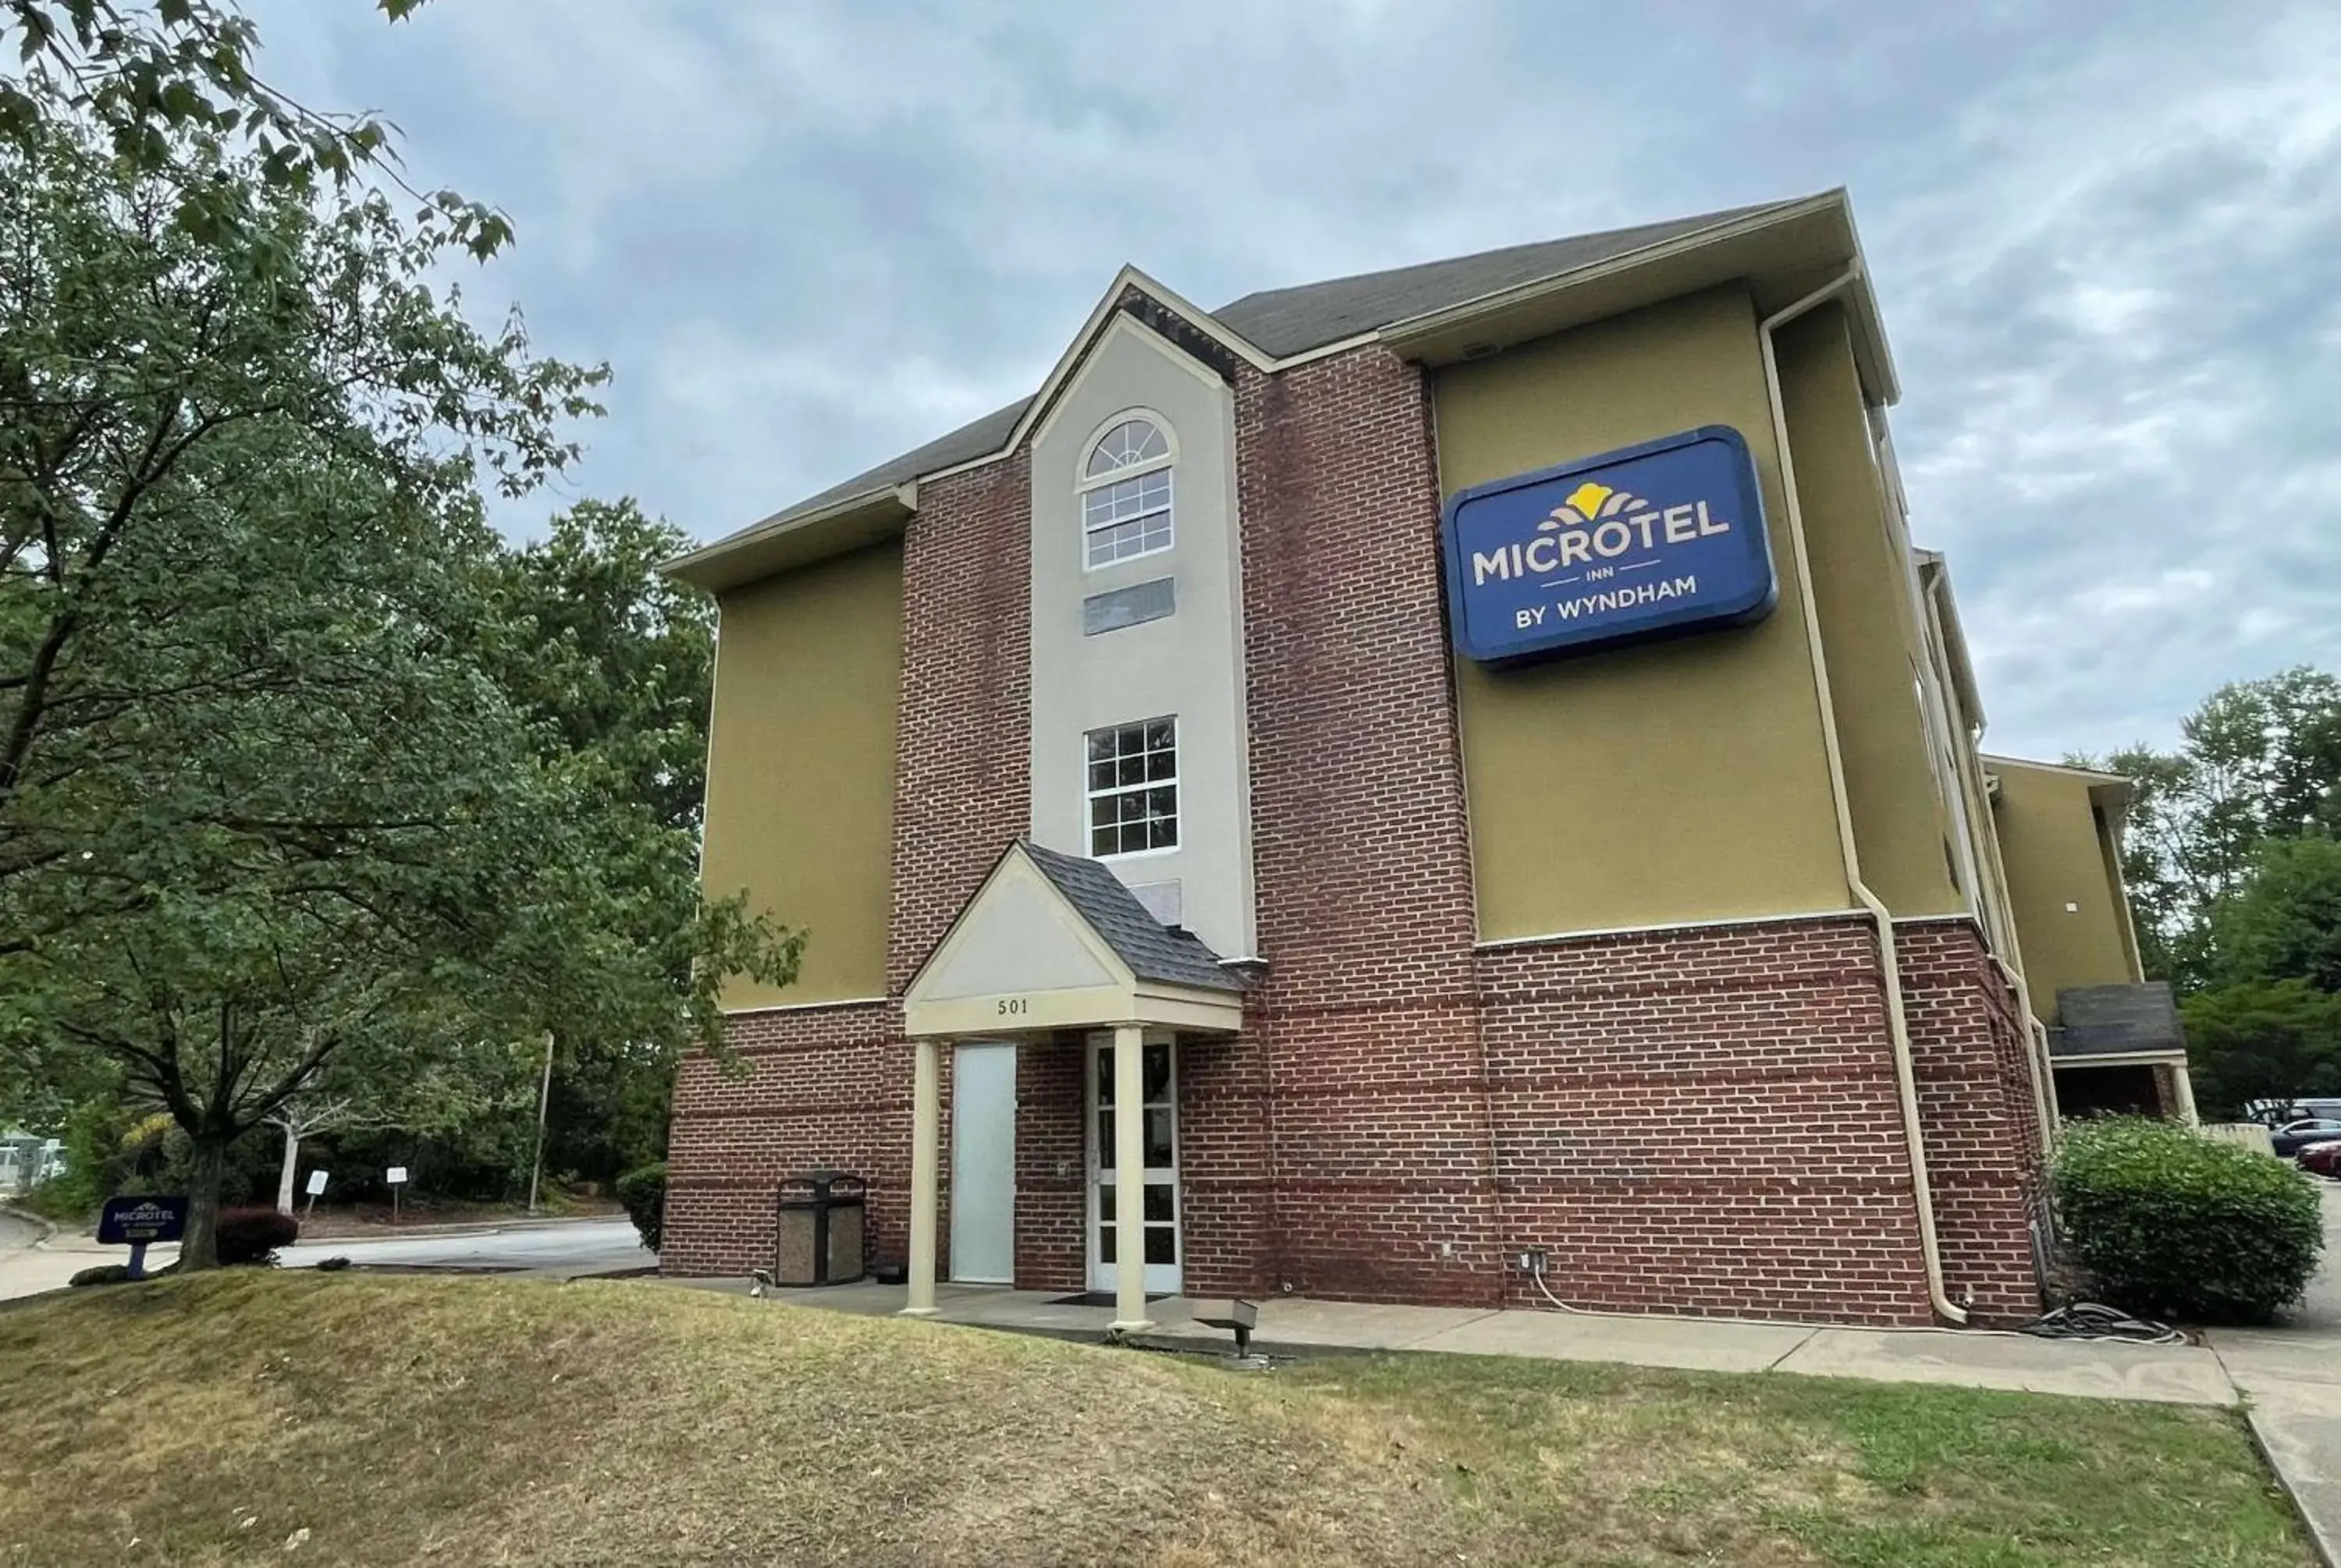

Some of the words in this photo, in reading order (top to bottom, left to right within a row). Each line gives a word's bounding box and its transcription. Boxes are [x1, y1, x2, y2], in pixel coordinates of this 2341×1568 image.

[1472, 499, 1730, 587] MICROTEL
[1586, 566, 1615, 582] INN
[1515, 605, 1547, 631] BY
[1557, 575, 1696, 620] WYNDHAM
[998, 998, 1027, 1015] 501
[113, 1210, 176, 1222] MICROTEL
